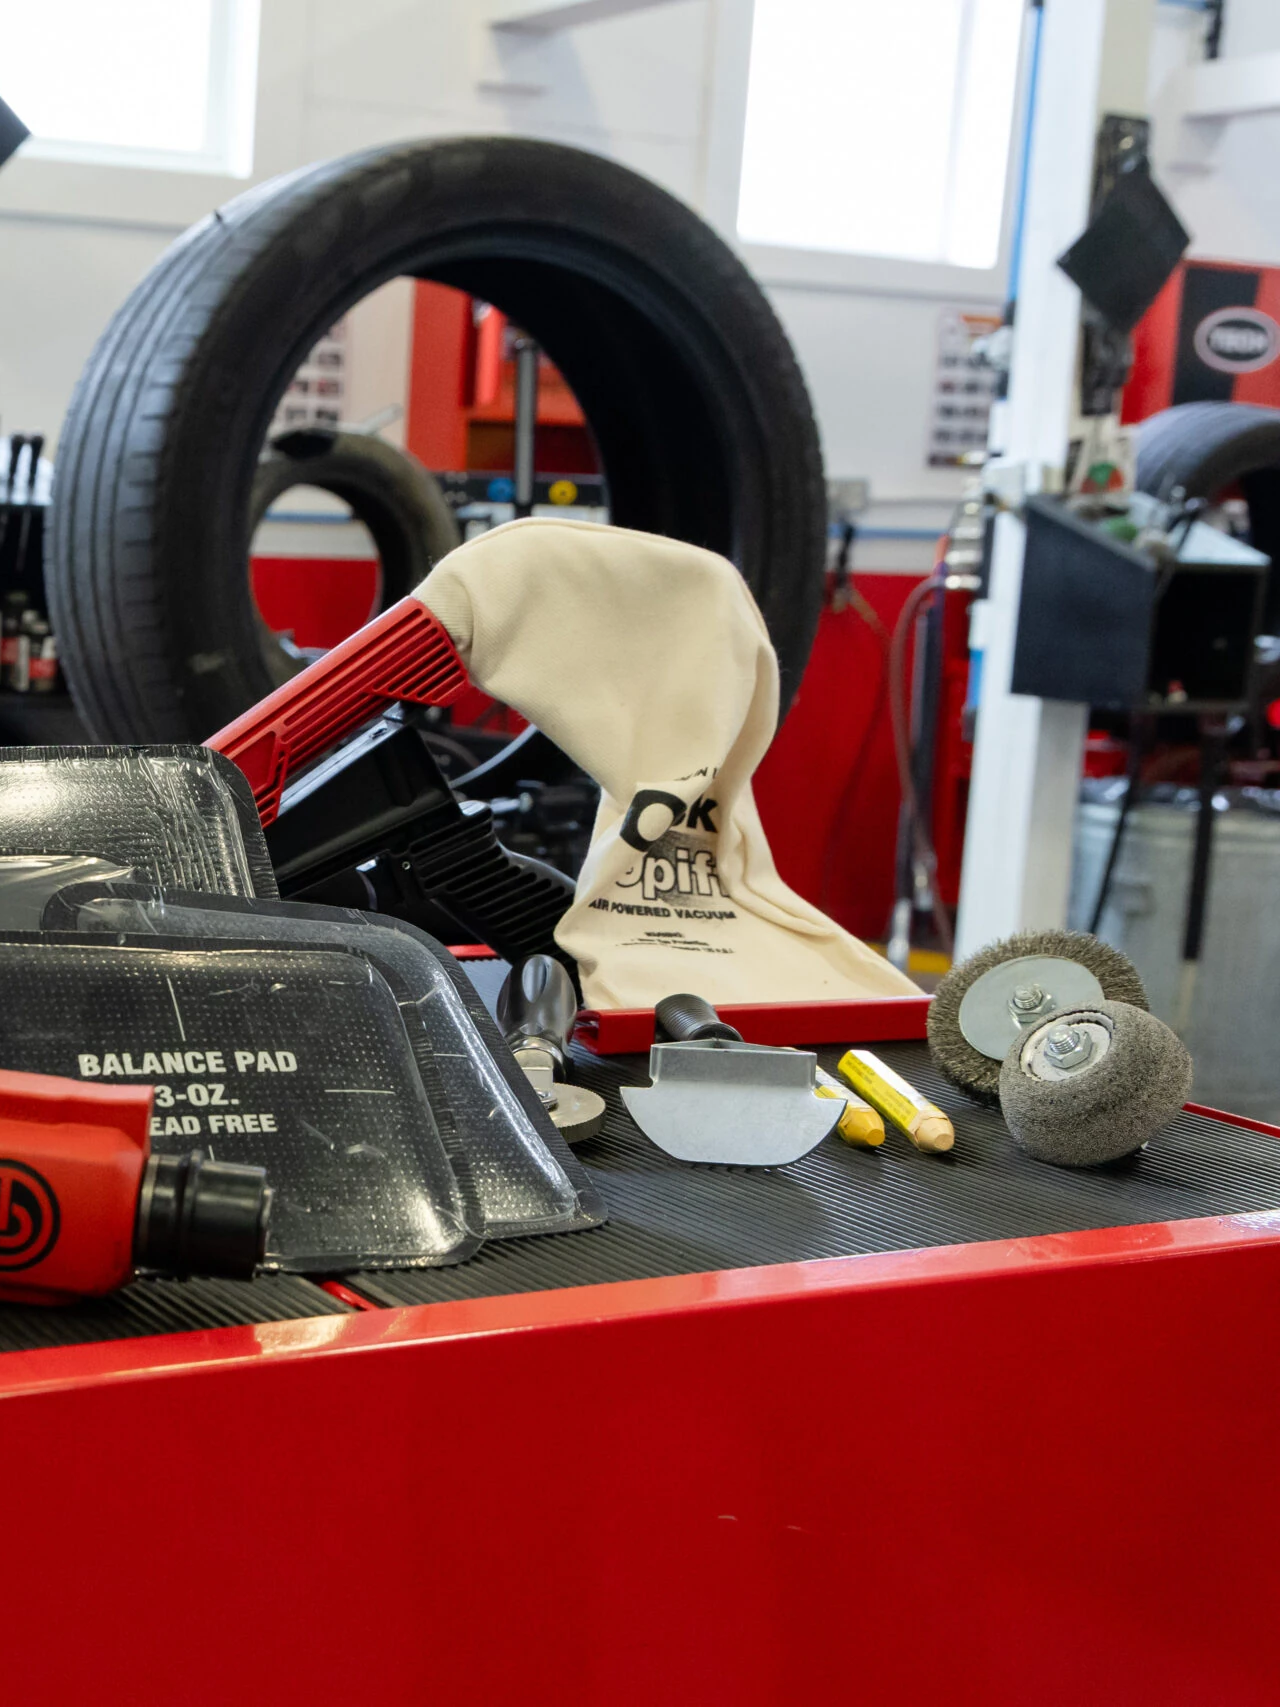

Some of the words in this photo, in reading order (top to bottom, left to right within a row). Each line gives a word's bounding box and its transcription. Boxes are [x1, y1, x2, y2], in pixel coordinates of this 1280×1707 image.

[588, 898, 610, 911] AIR
[611, 902, 671, 918] POWERED
[674, 908, 737, 920] VACUUM
[78, 1051, 227, 1077] BALANCE
[234, 1051, 298, 1073] PAD
[153, 1083, 240, 1108] 3-OZ.
[149, 1115, 202, 1137] EAD
[208, 1113, 278, 1134] FREE
